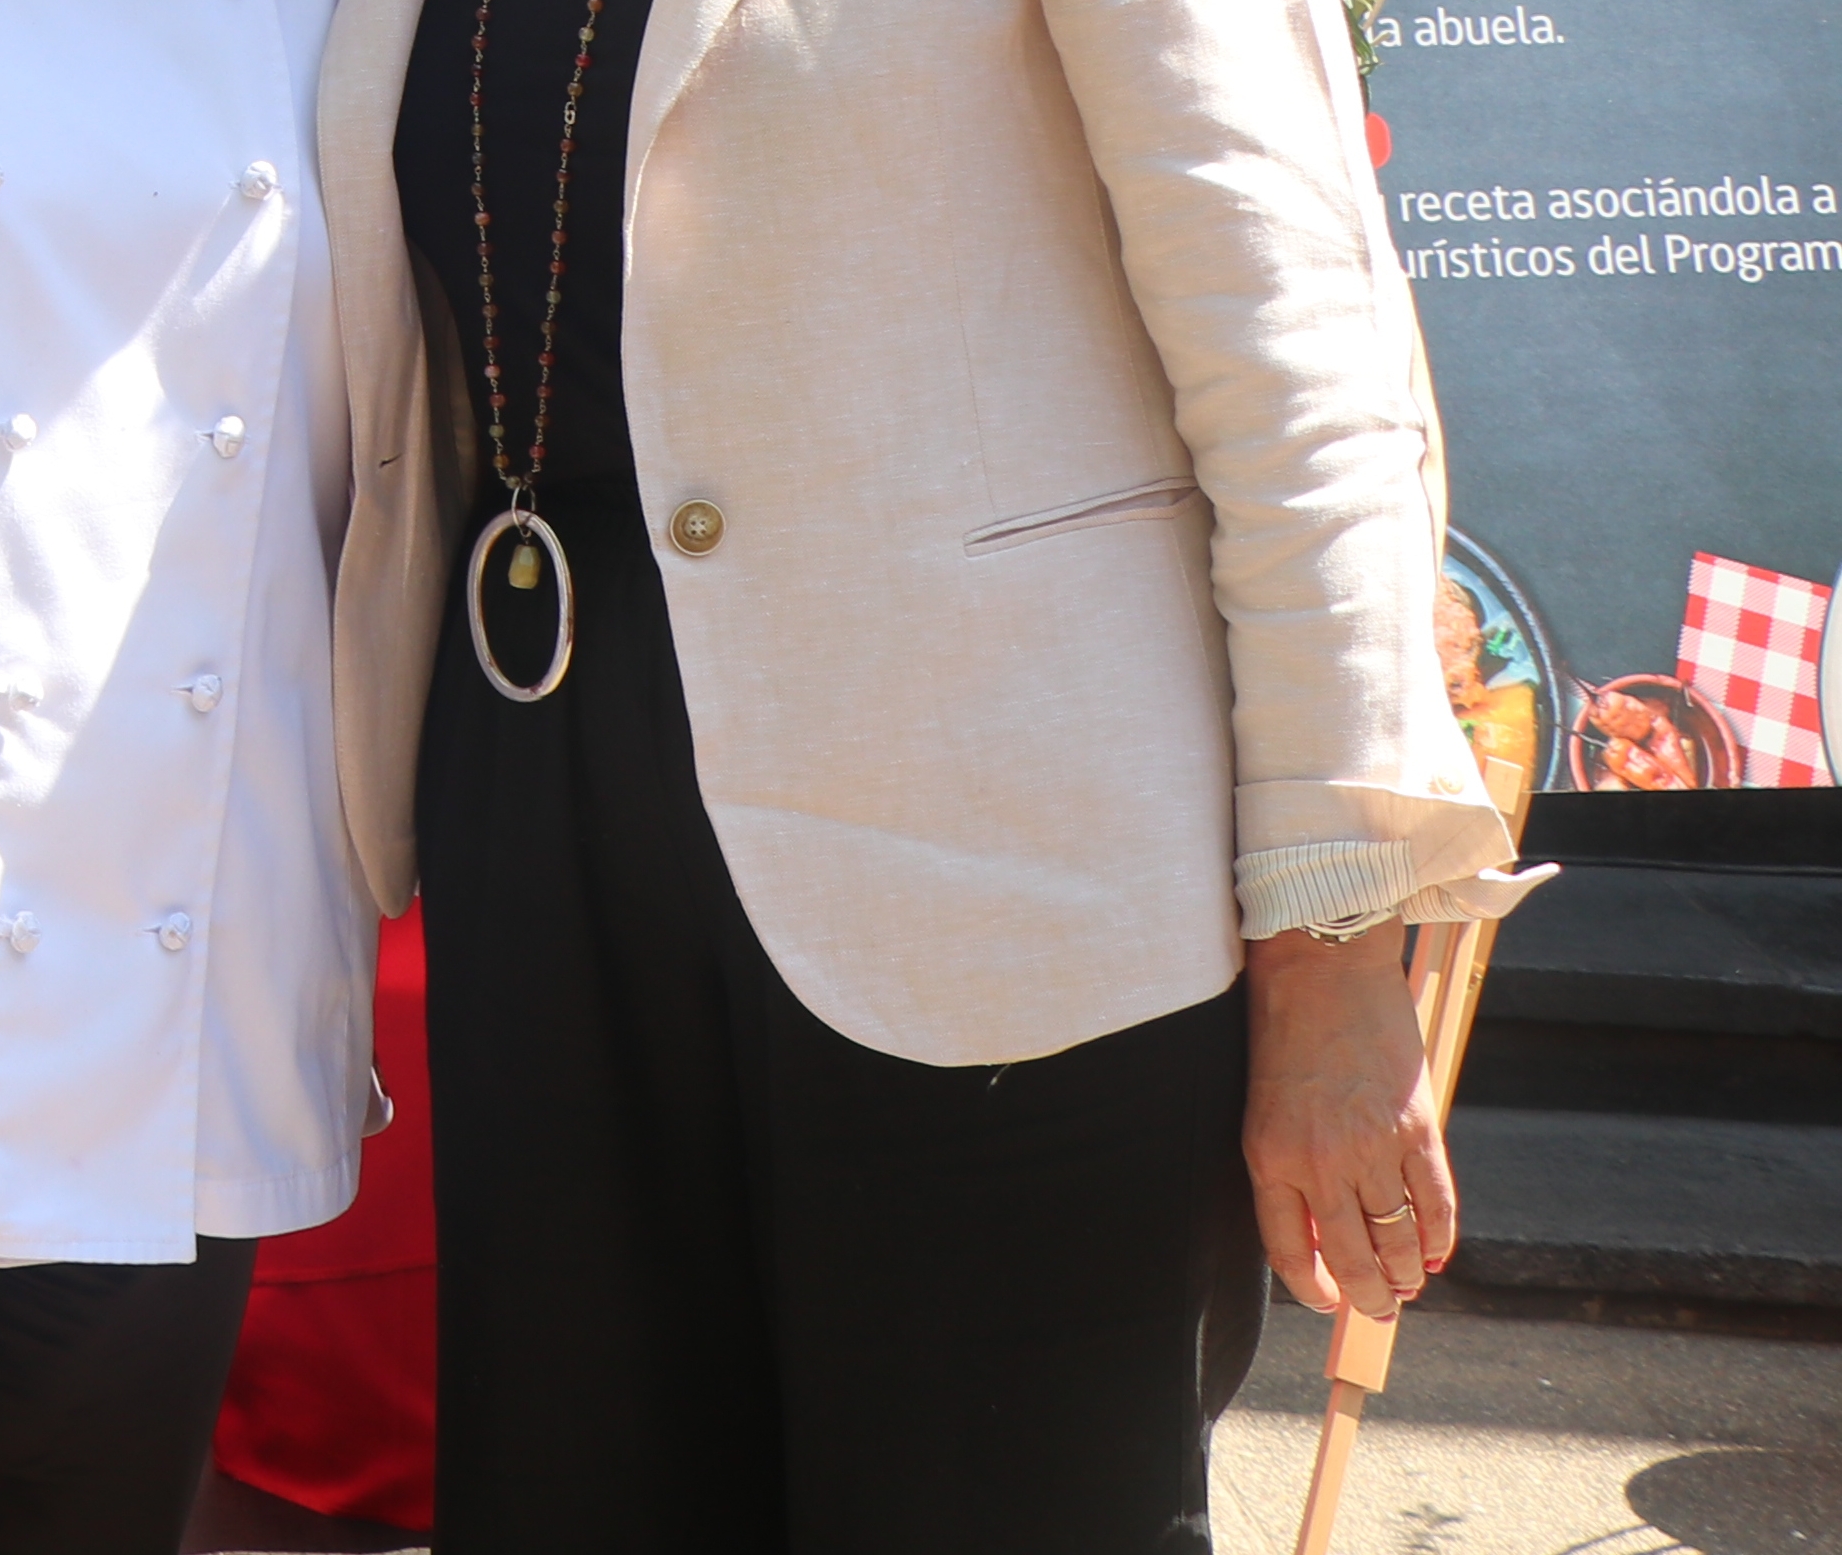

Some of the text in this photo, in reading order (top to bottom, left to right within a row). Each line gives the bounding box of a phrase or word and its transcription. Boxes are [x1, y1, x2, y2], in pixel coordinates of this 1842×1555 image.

[1414, 5, 1565, 47] abuela.
[1399, 185, 1537, 222] receta
[1548, 174, 1801, 219] asociándola
[1812, 183, 1838, 214] a
[1588, 234, 1656, 276] del
[1664, 233, 1842, 284] Program
